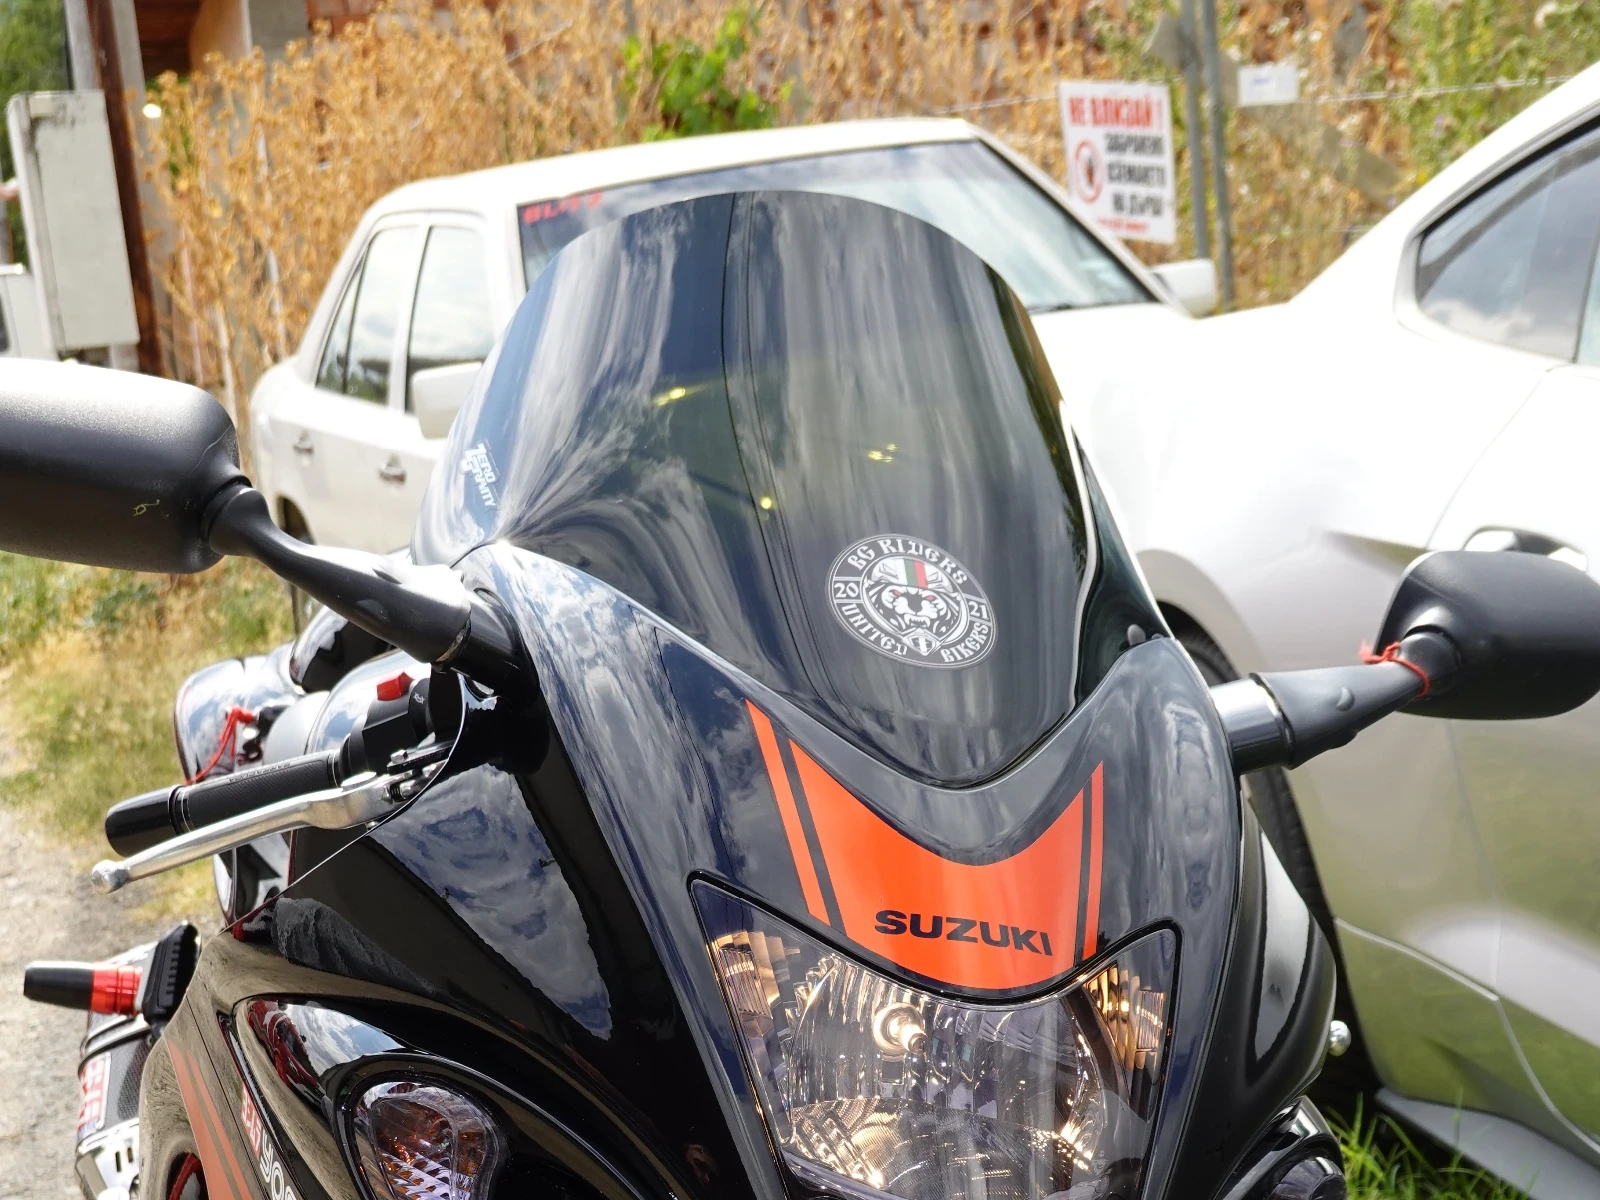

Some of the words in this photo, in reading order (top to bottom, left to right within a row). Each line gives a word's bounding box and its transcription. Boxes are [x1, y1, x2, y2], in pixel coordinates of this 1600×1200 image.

[464, 442, 496, 483] ZERO
[847, 545, 876, 571] BG
[877, 538, 968, 585] RIDERS
[834, 582, 860, 598] 20
[841, 602, 908, 656] UNITED
[968, 601, 990, 621] 21
[940, 622, 990, 663] BIKERS
[874, 909, 1053, 957] SUZUKI
